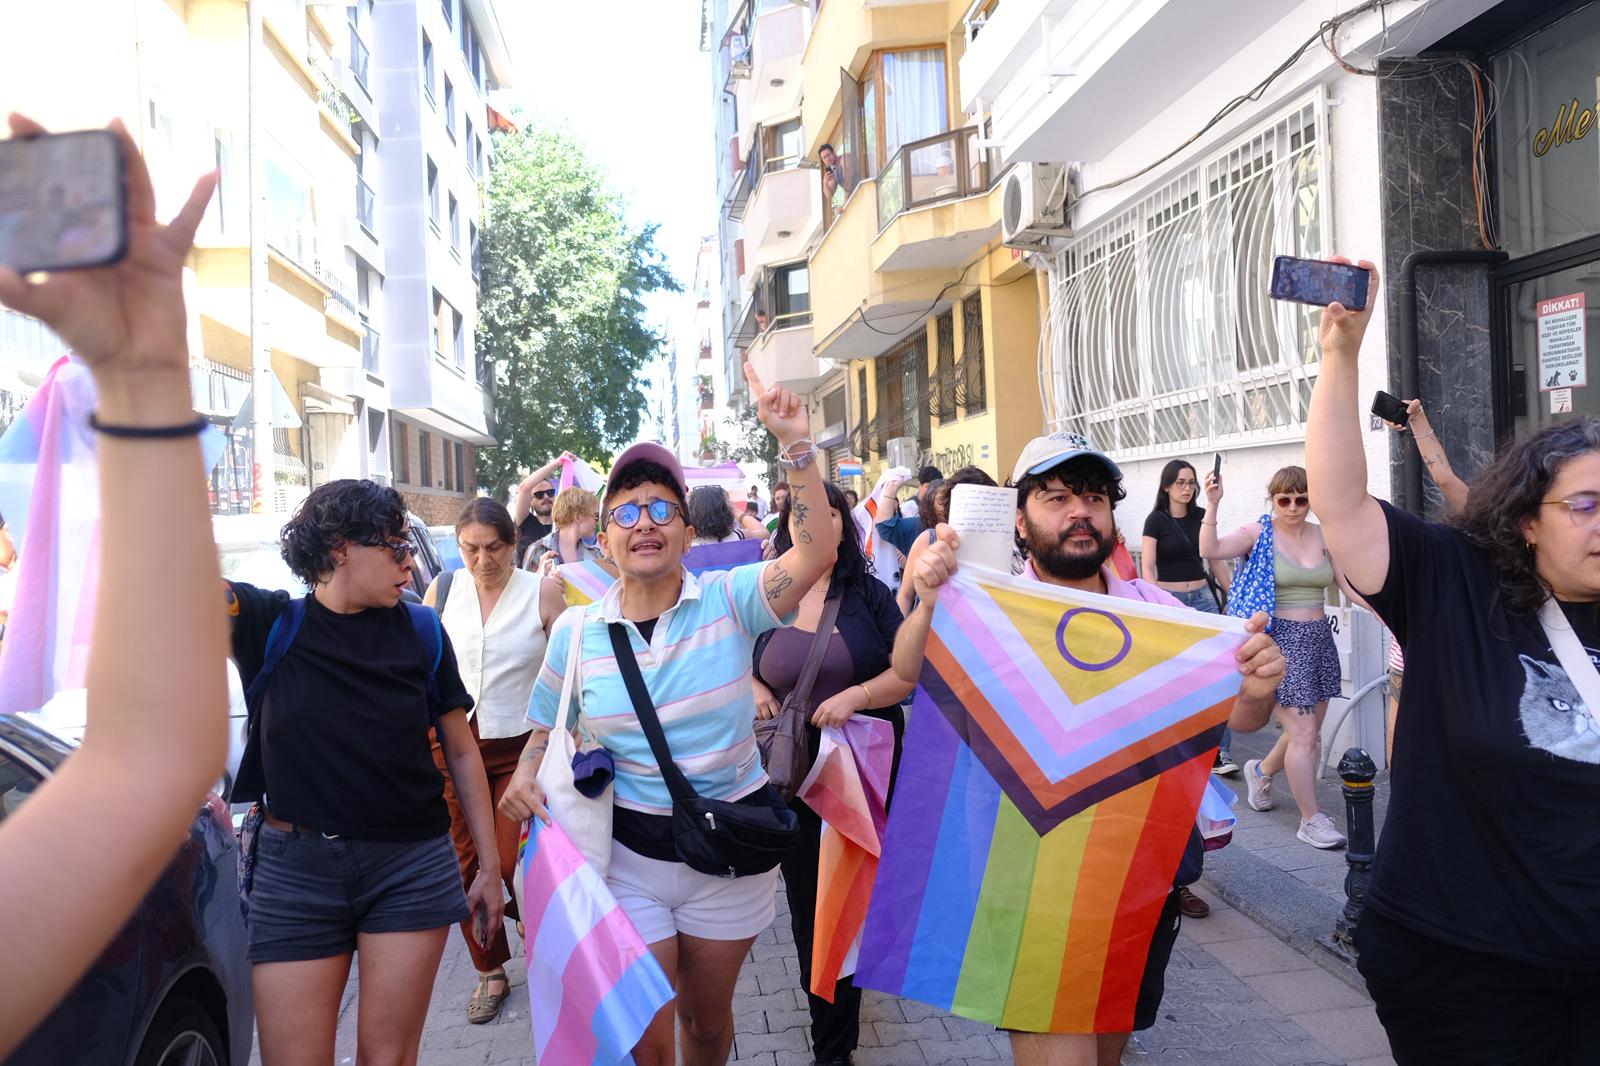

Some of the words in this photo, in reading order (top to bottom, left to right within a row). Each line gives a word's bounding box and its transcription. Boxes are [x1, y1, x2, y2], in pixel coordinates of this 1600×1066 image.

[1533, 98, 1600, 157] Me
[1542, 298, 1579, 315] DİKKAT!
[1548, 340, 1576, 350] TARAFINDAN
